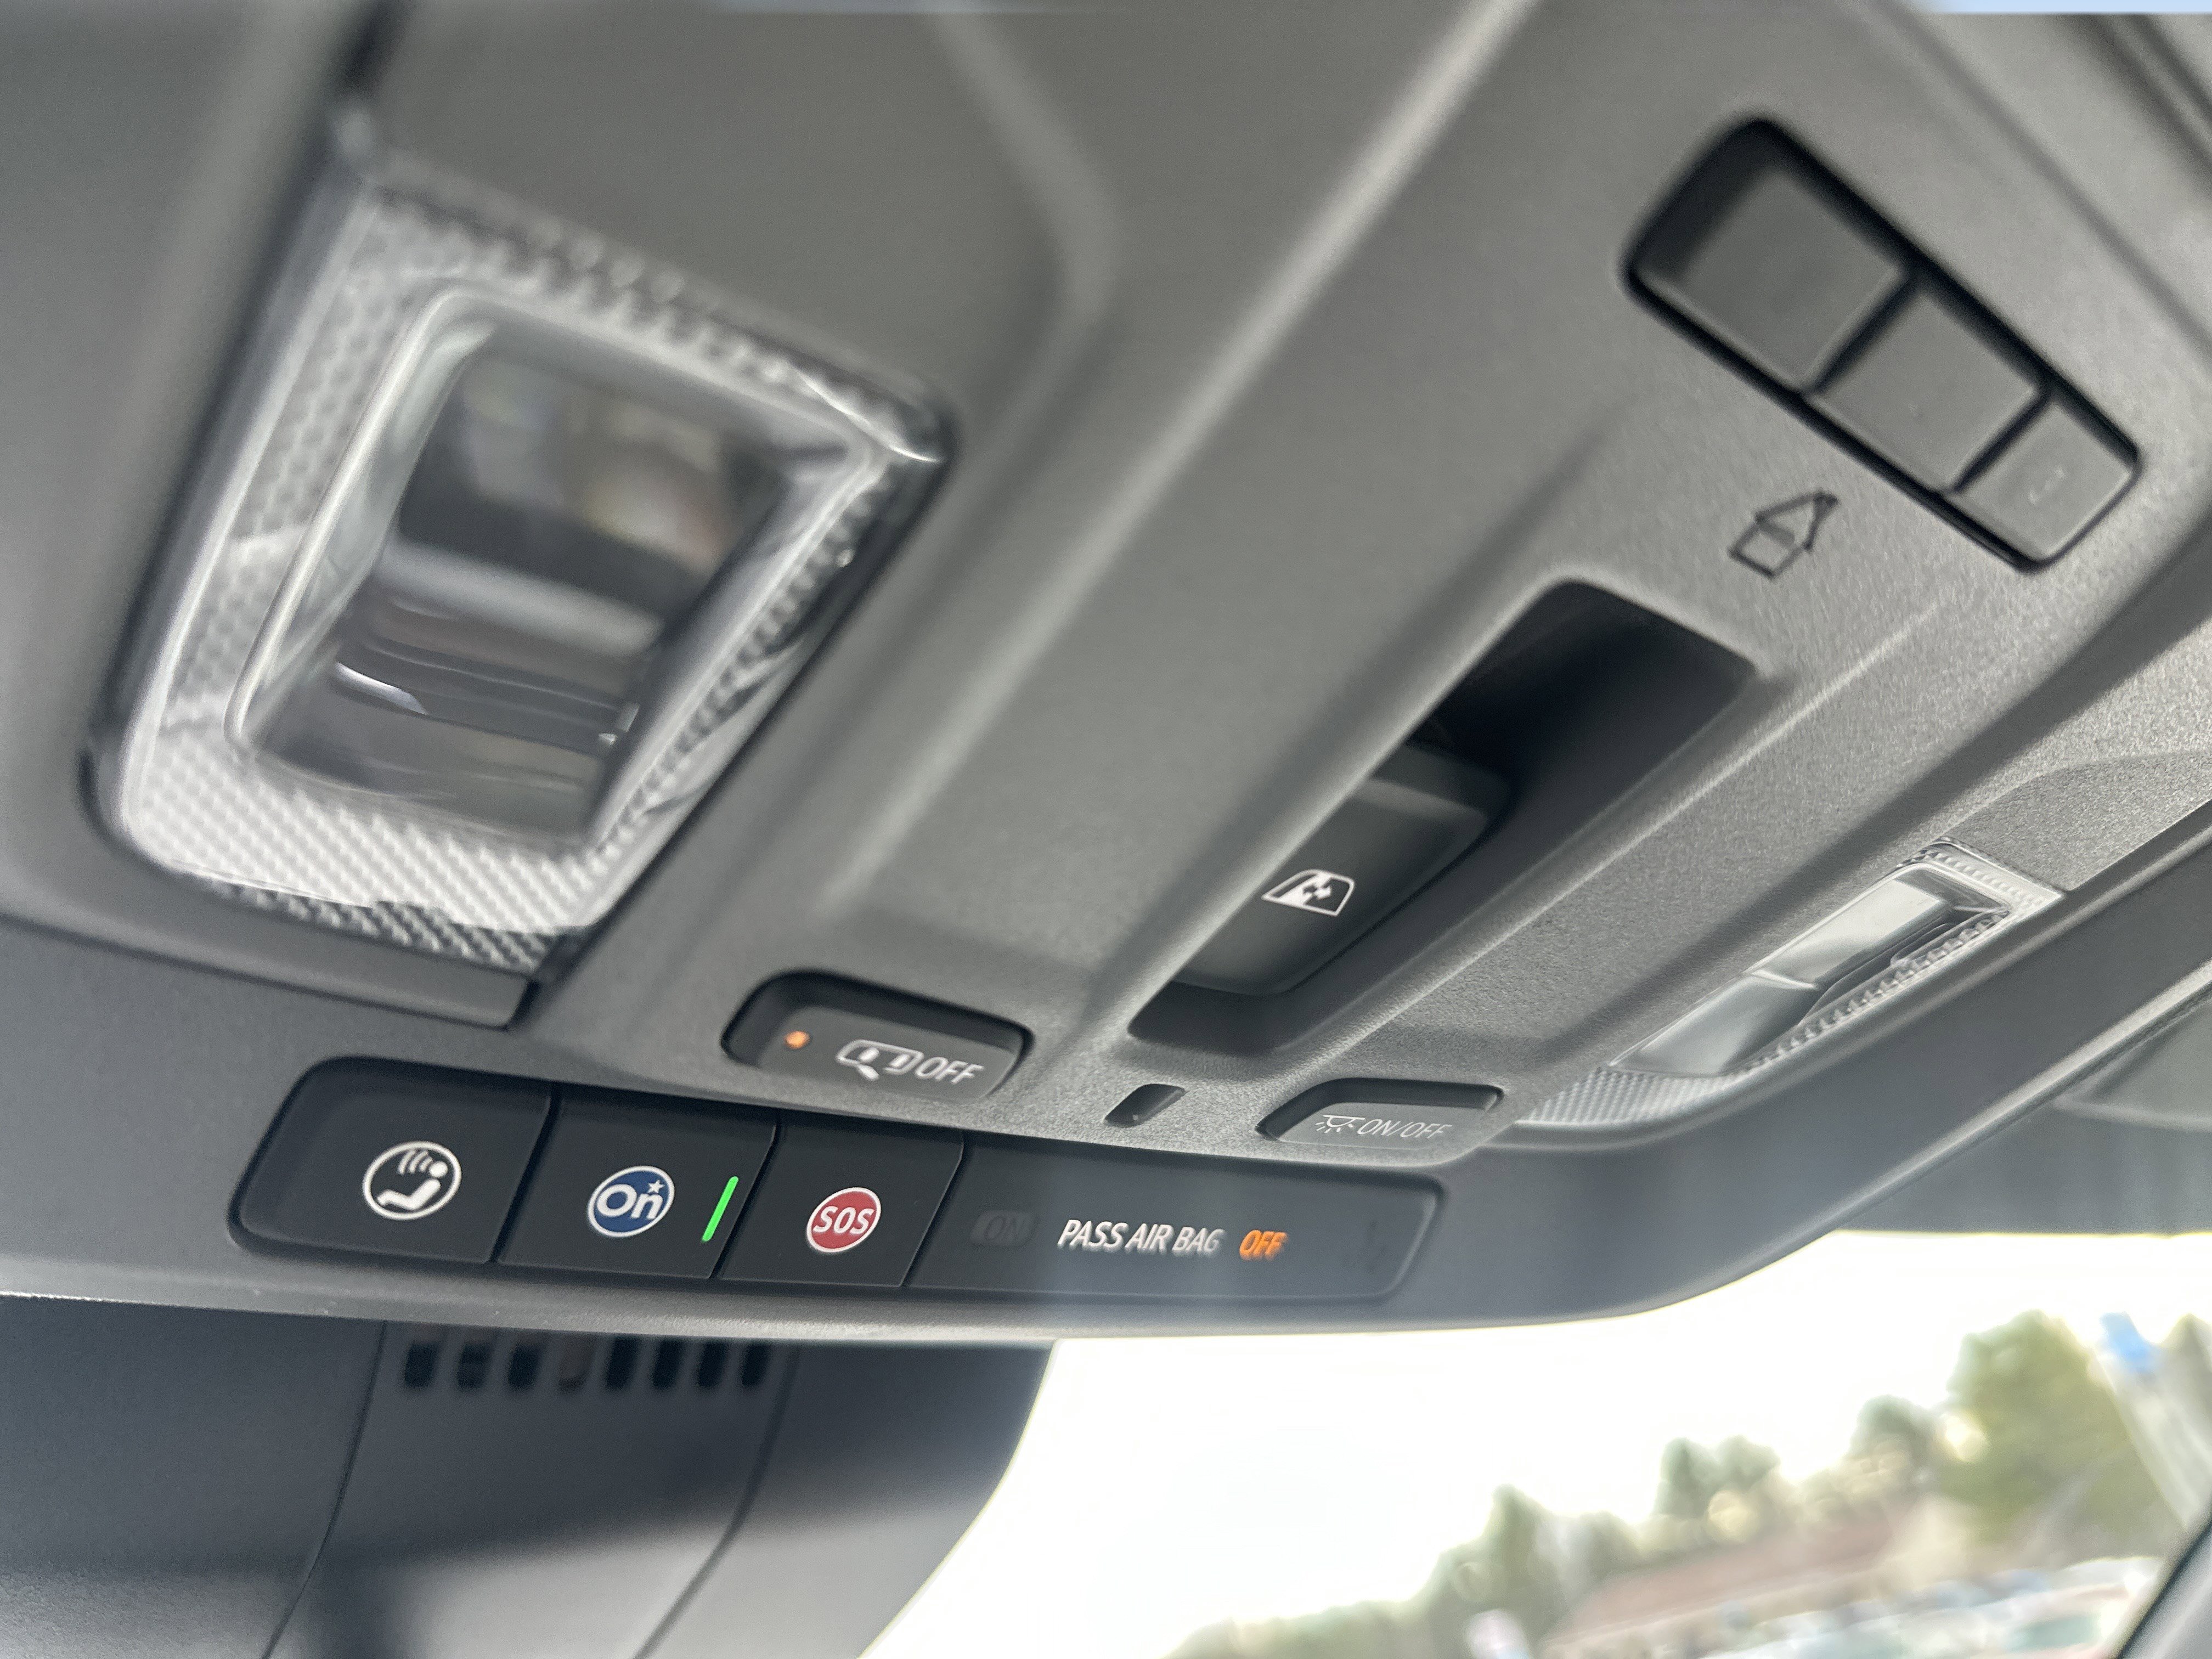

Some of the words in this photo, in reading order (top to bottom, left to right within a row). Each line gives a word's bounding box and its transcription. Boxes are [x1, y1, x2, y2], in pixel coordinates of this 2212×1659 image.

[915, 1056, 984, 1084] OFF
[1357, 1118, 1452, 1139] ON/OFF
[596, 1183, 664, 1220] On
[812, 1205, 876, 1235] SOS
[984, 1215, 1028, 1242] ON
[1057, 1219, 1129, 1251] PASS
[1125, 1223, 1175, 1254] AIR
[1171, 1226, 1226, 1257] BAG
[1239, 1229, 1288, 1260] OFF
